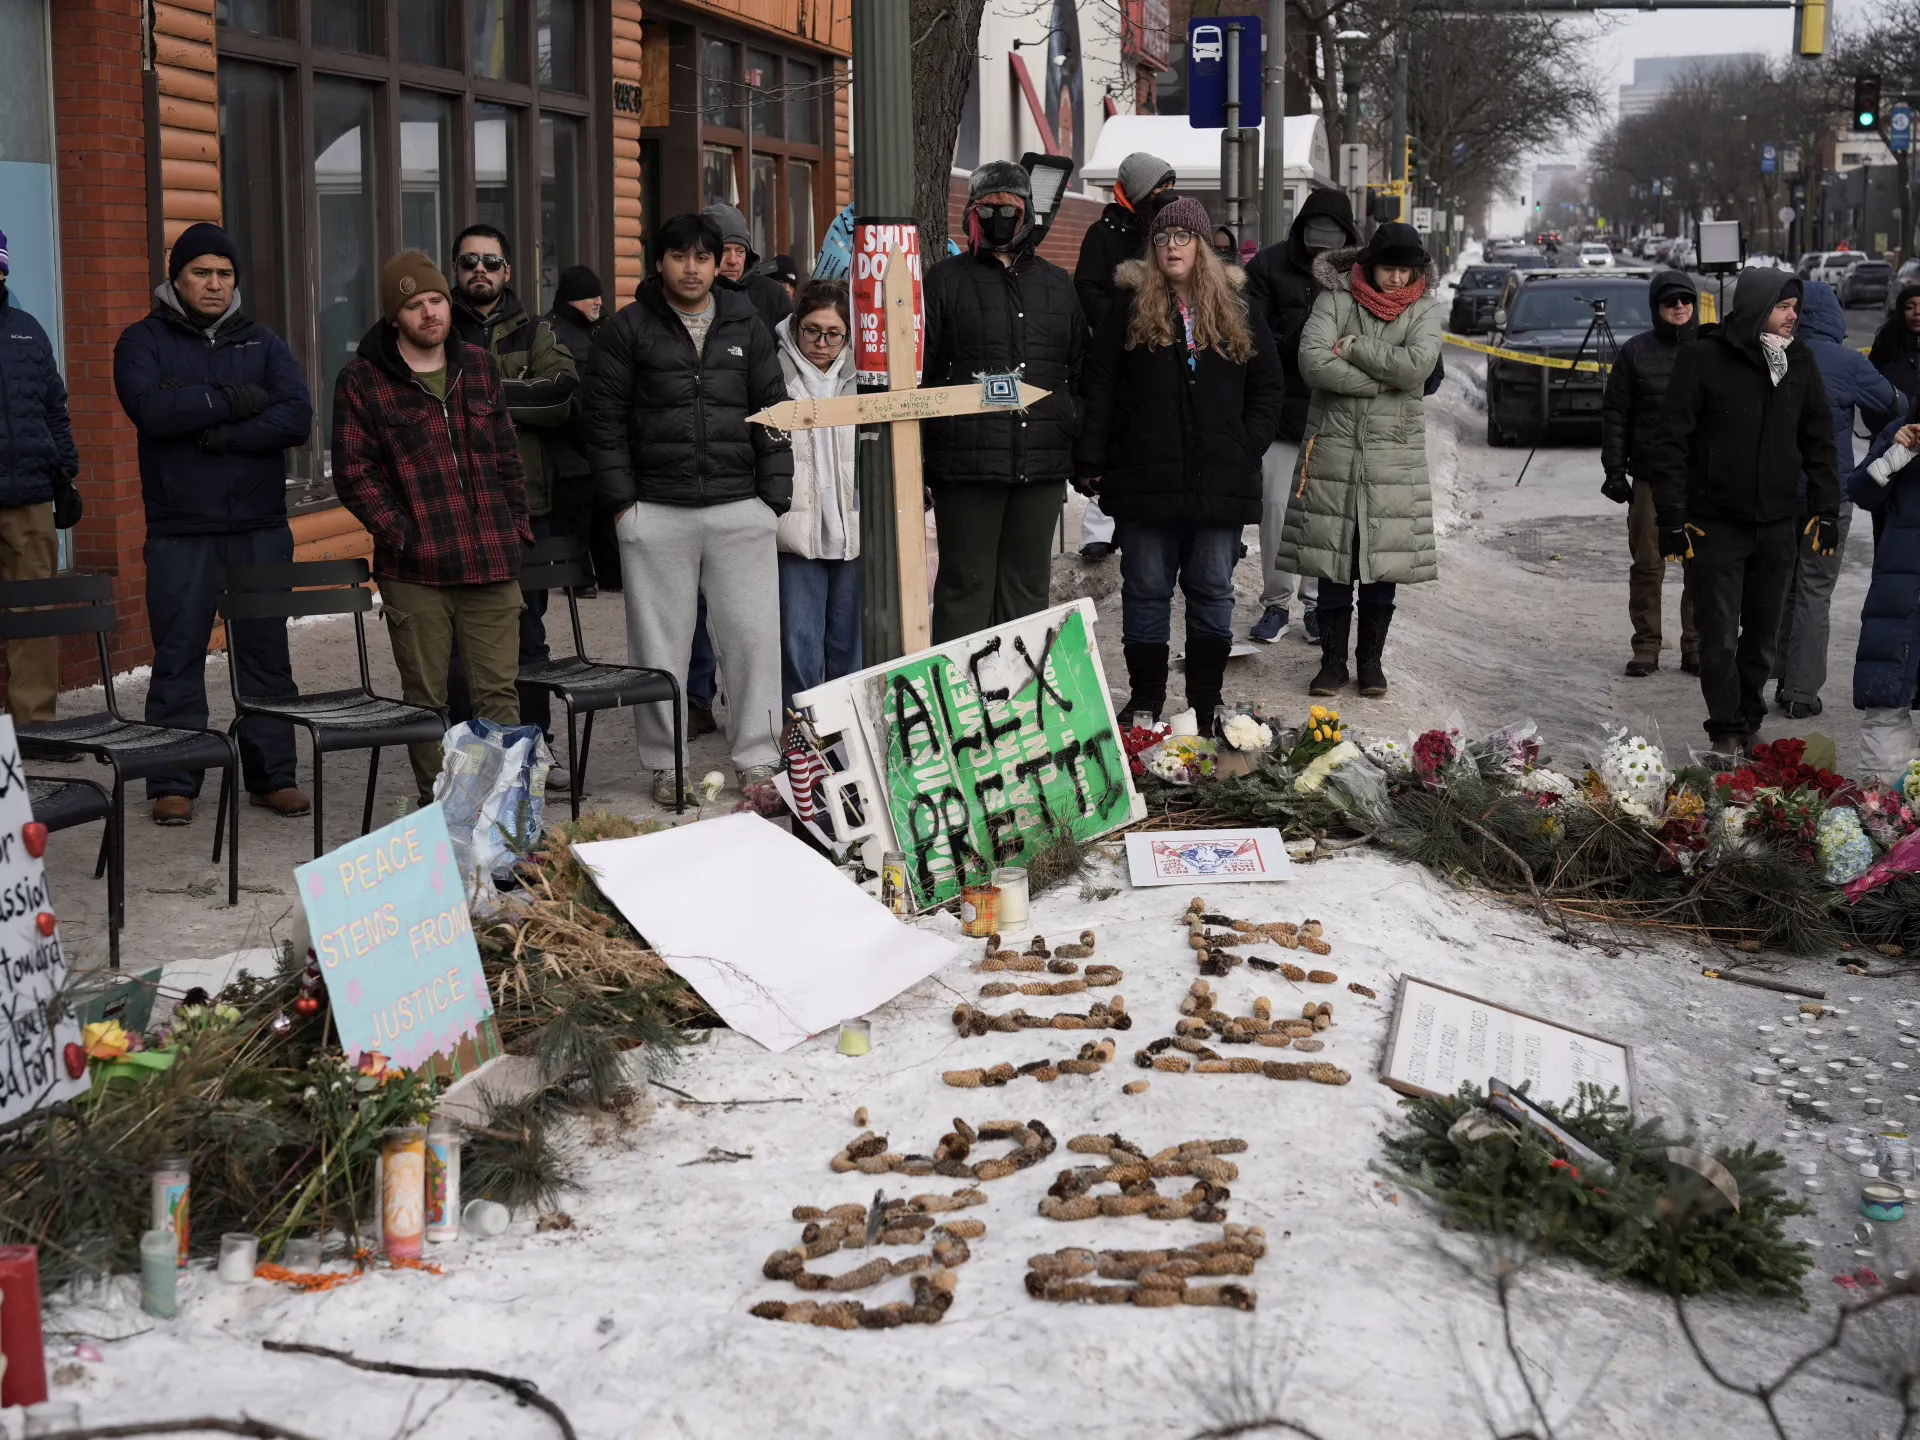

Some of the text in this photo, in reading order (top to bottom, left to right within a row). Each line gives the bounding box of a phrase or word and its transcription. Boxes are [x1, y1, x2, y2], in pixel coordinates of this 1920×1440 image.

[863, 224, 916, 254] SHUT
[860, 313, 878, 329] NO
[862, 329, 878, 343] NO
[865, 343, 878, 353] NO
[893, 627, 1074, 767] ALEX
[907, 728, 1125, 897] PRETTI
[338, 827, 425, 897] PEACE
[319, 898, 473, 970] STEMS FROM
[0, 930, 66, 994] toward
[371, 967, 466, 1049] JUSTICE
[1413, 1000, 1434, 1044] COURAGEOUS
[1466, 1009, 1490, 1057] DISCOURAGED
[1525, 1032, 1540, 1049] YOU
